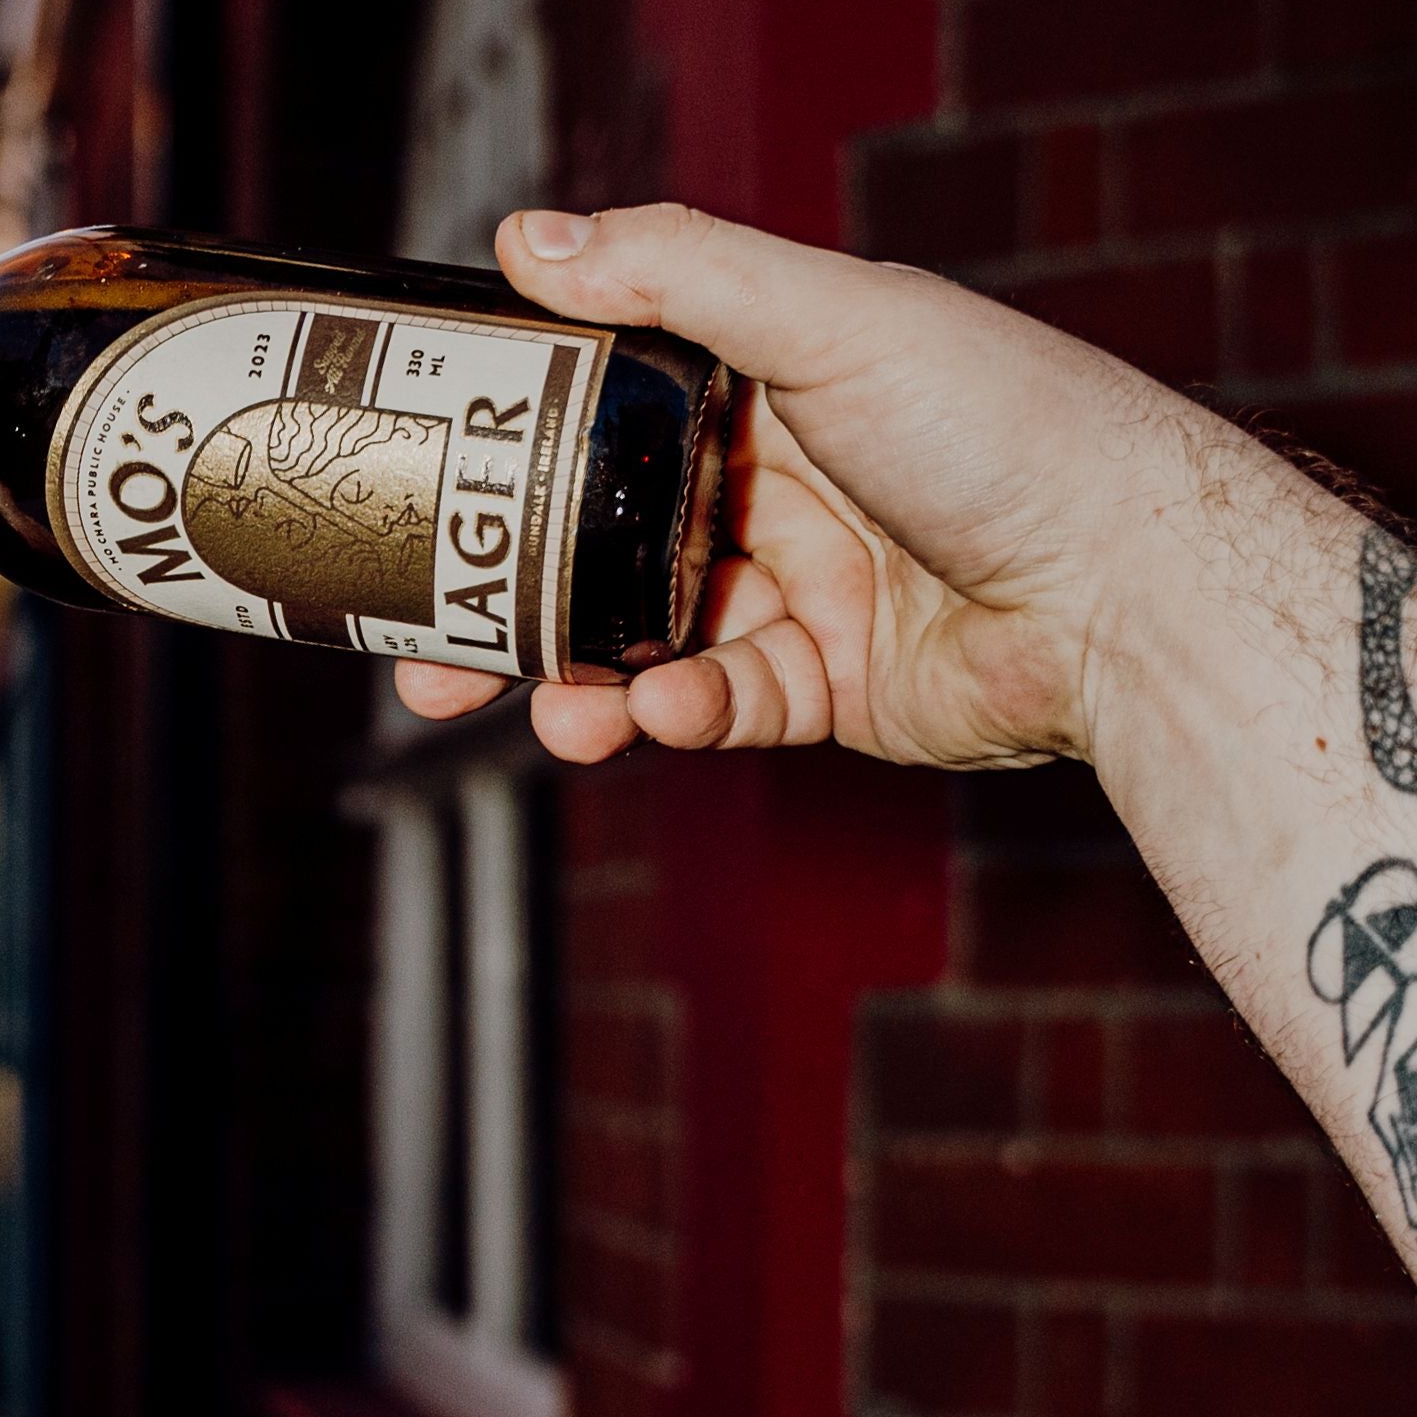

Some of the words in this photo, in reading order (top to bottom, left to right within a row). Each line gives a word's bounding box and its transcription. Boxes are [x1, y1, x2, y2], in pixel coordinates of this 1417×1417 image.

[248, 333, 270, 378] 2023
[407, 349, 424, 377] 330
[429, 355, 445, 377] ML
[97, 397, 126, 443] HOUSE
[537, 407, 559, 472] IRELAND
[88, 446, 102, 497] PUBLIC
[108, 393, 205, 585] MO'S
[90, 502, 107, 544] CHARA
[444, 396, 531, 653] LAGER
[528, 485, 547, 557] DUNDALK
[103, 547, 119, 565] MO
[236, 605, 254, 629] ESTD
